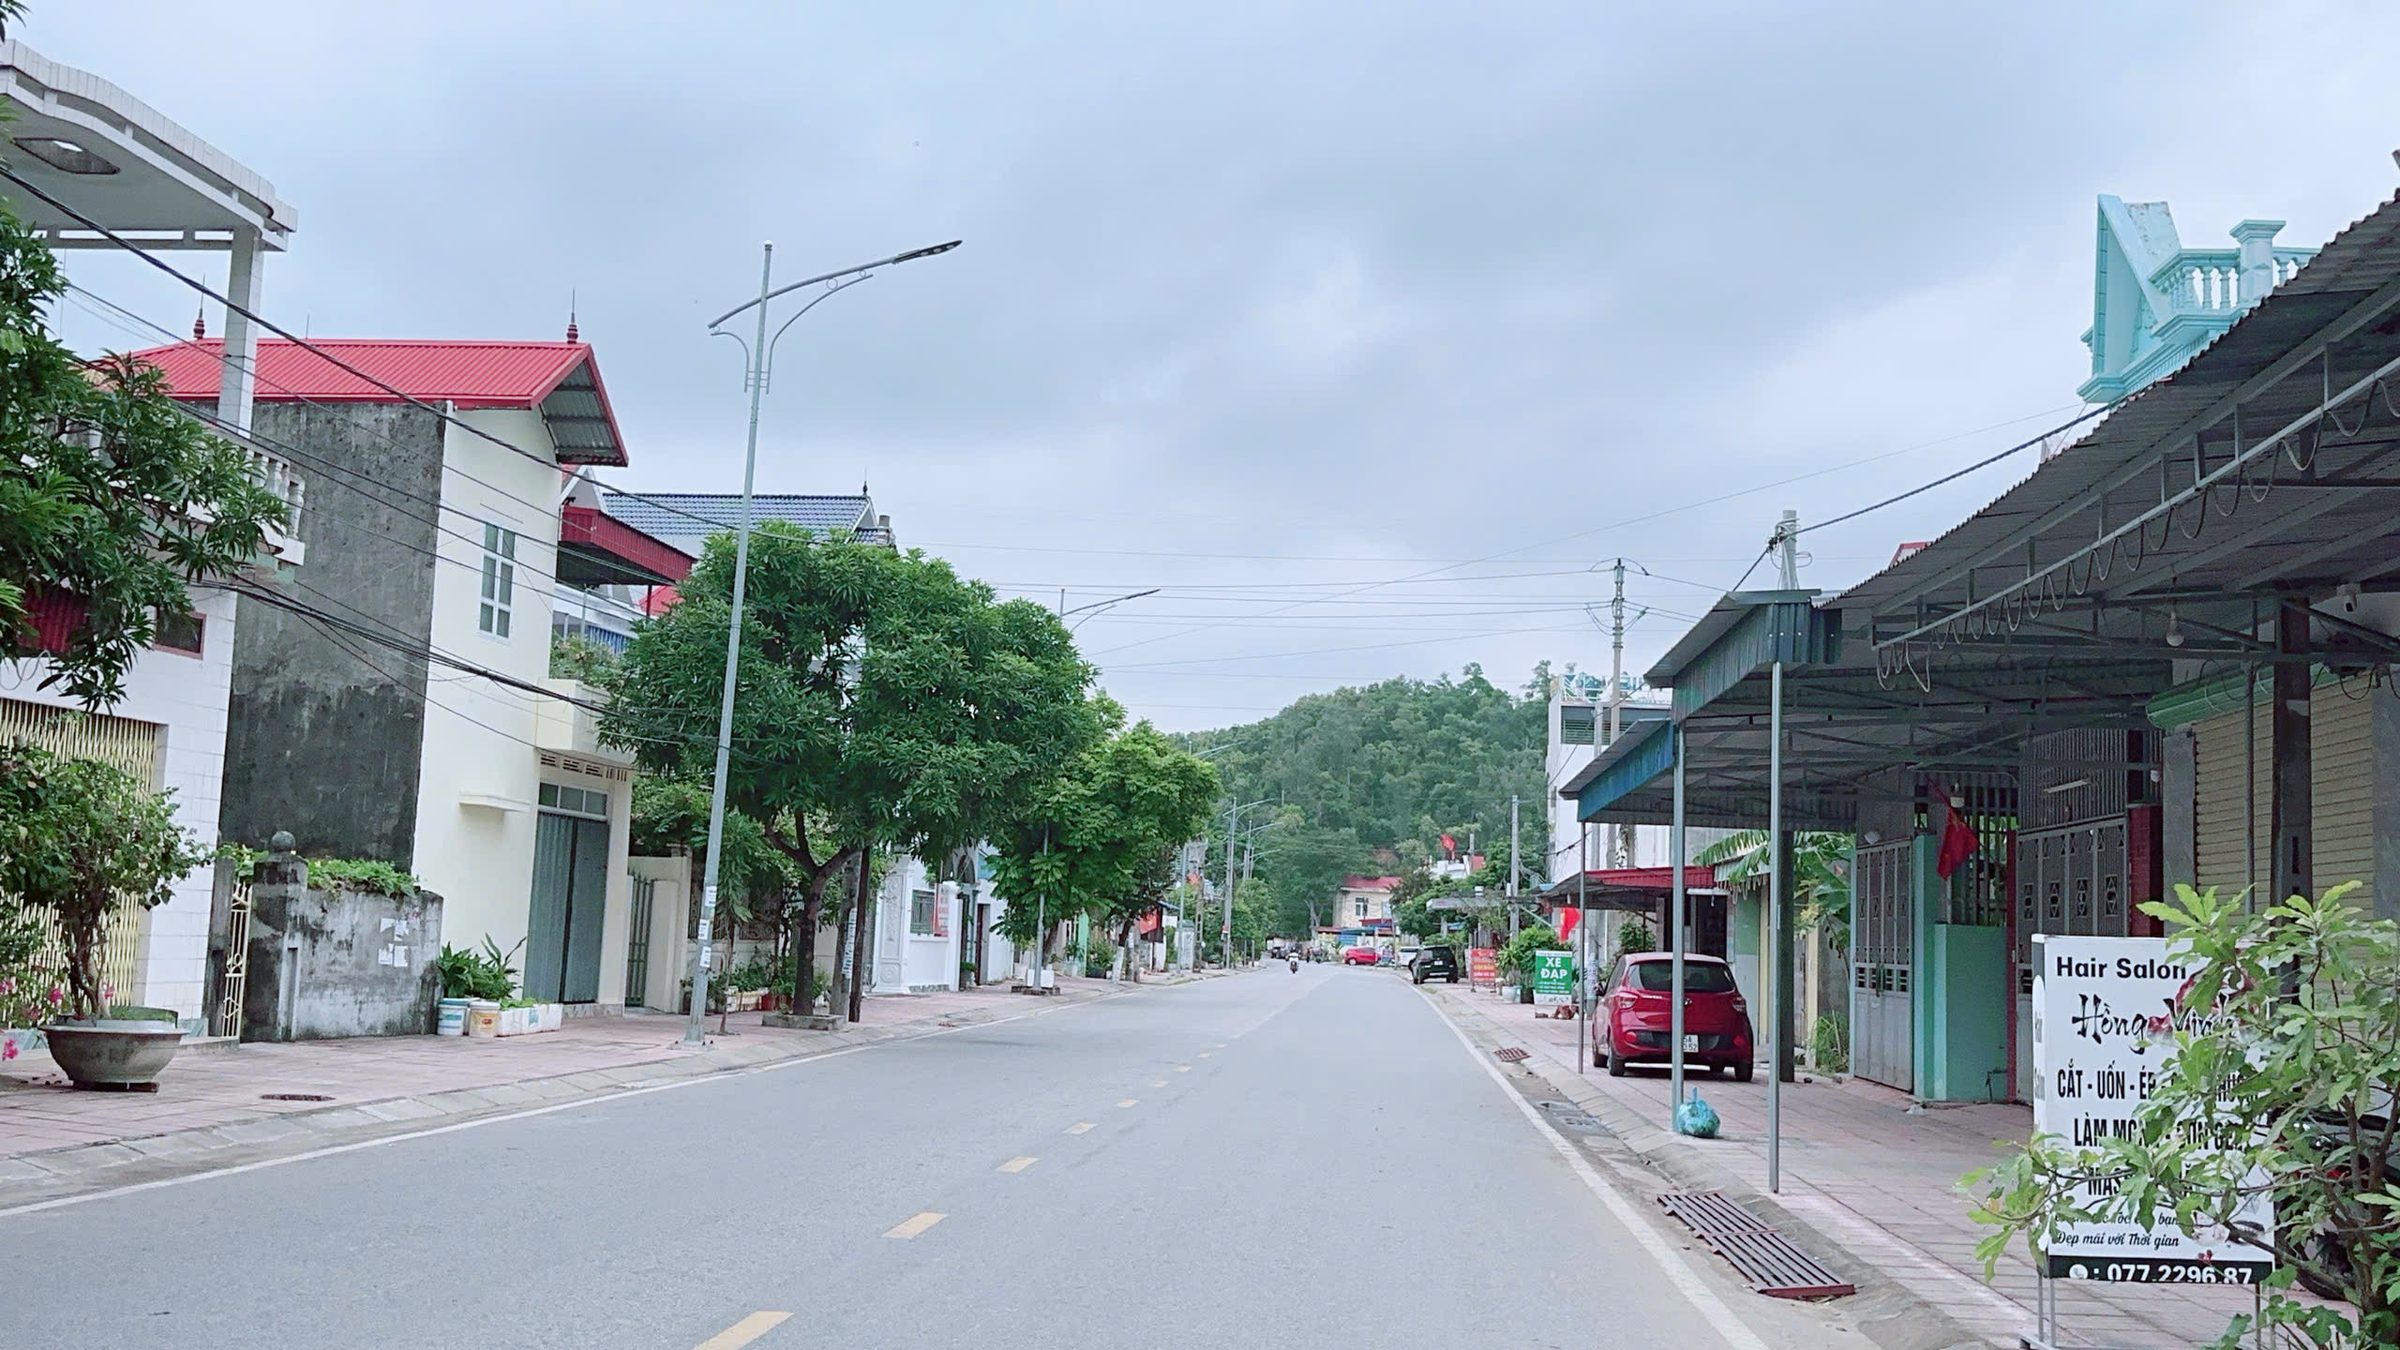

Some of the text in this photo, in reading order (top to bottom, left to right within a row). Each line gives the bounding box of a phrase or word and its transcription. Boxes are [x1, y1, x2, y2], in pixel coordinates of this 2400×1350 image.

[1540, 967, 1568, 982] ĐẠP
[1545, 957, 1562, 968] XE
[2056, 956, 2186, 980] Hair Salon
[2071, 993, 2147, 1055] Hồng
[2057, 1058, 2083, 1098] CẮT
[2097, 1060, 2125, 1099] UỐN
[2074, 1112, 2107, 1147] LÀM
[2154, 1233, 2180, 1251] gian
